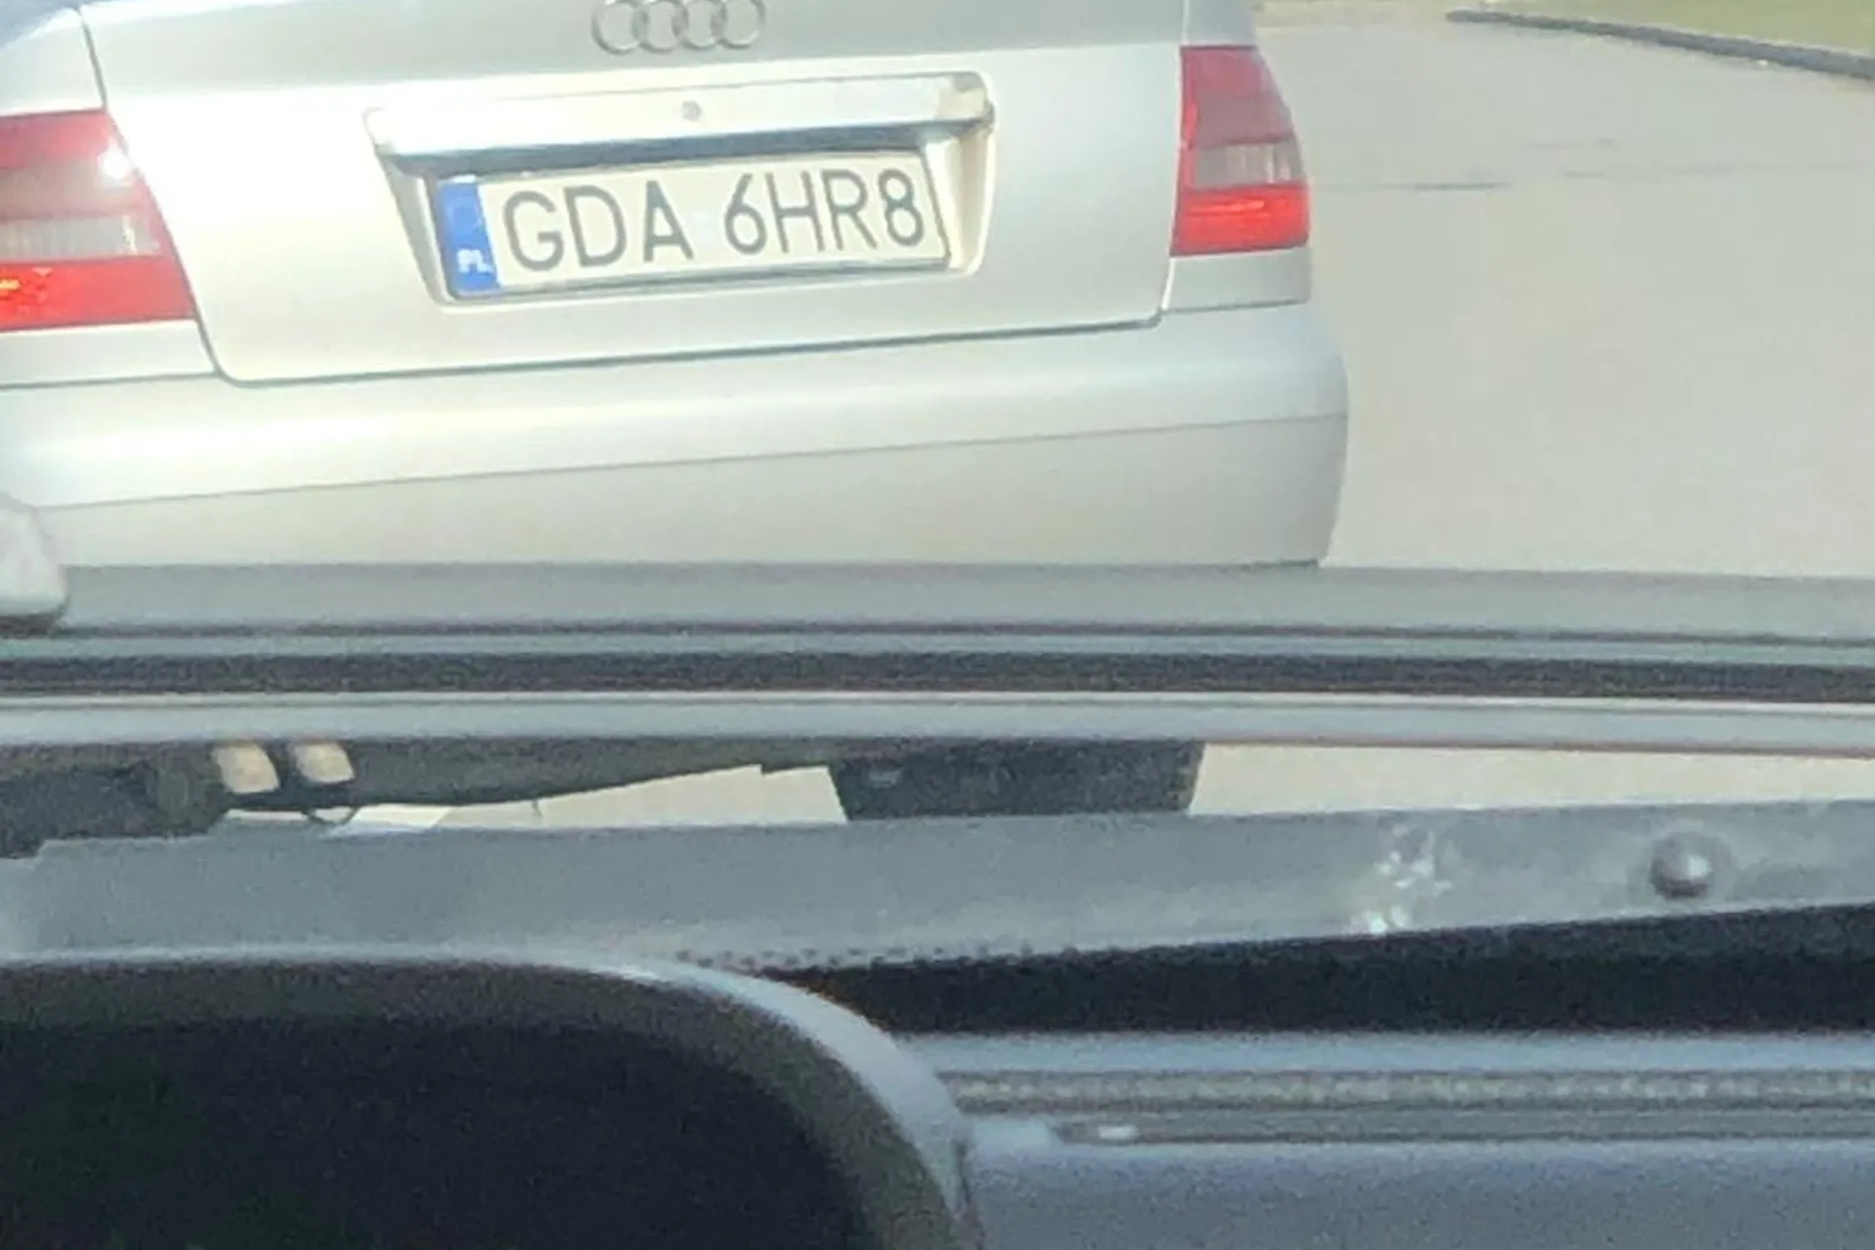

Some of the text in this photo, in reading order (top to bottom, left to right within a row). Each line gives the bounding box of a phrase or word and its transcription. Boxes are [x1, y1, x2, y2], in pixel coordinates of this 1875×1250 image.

[501, 167, 925, 273] GDA 6HR8
[456, 249, 493, 274] PL
